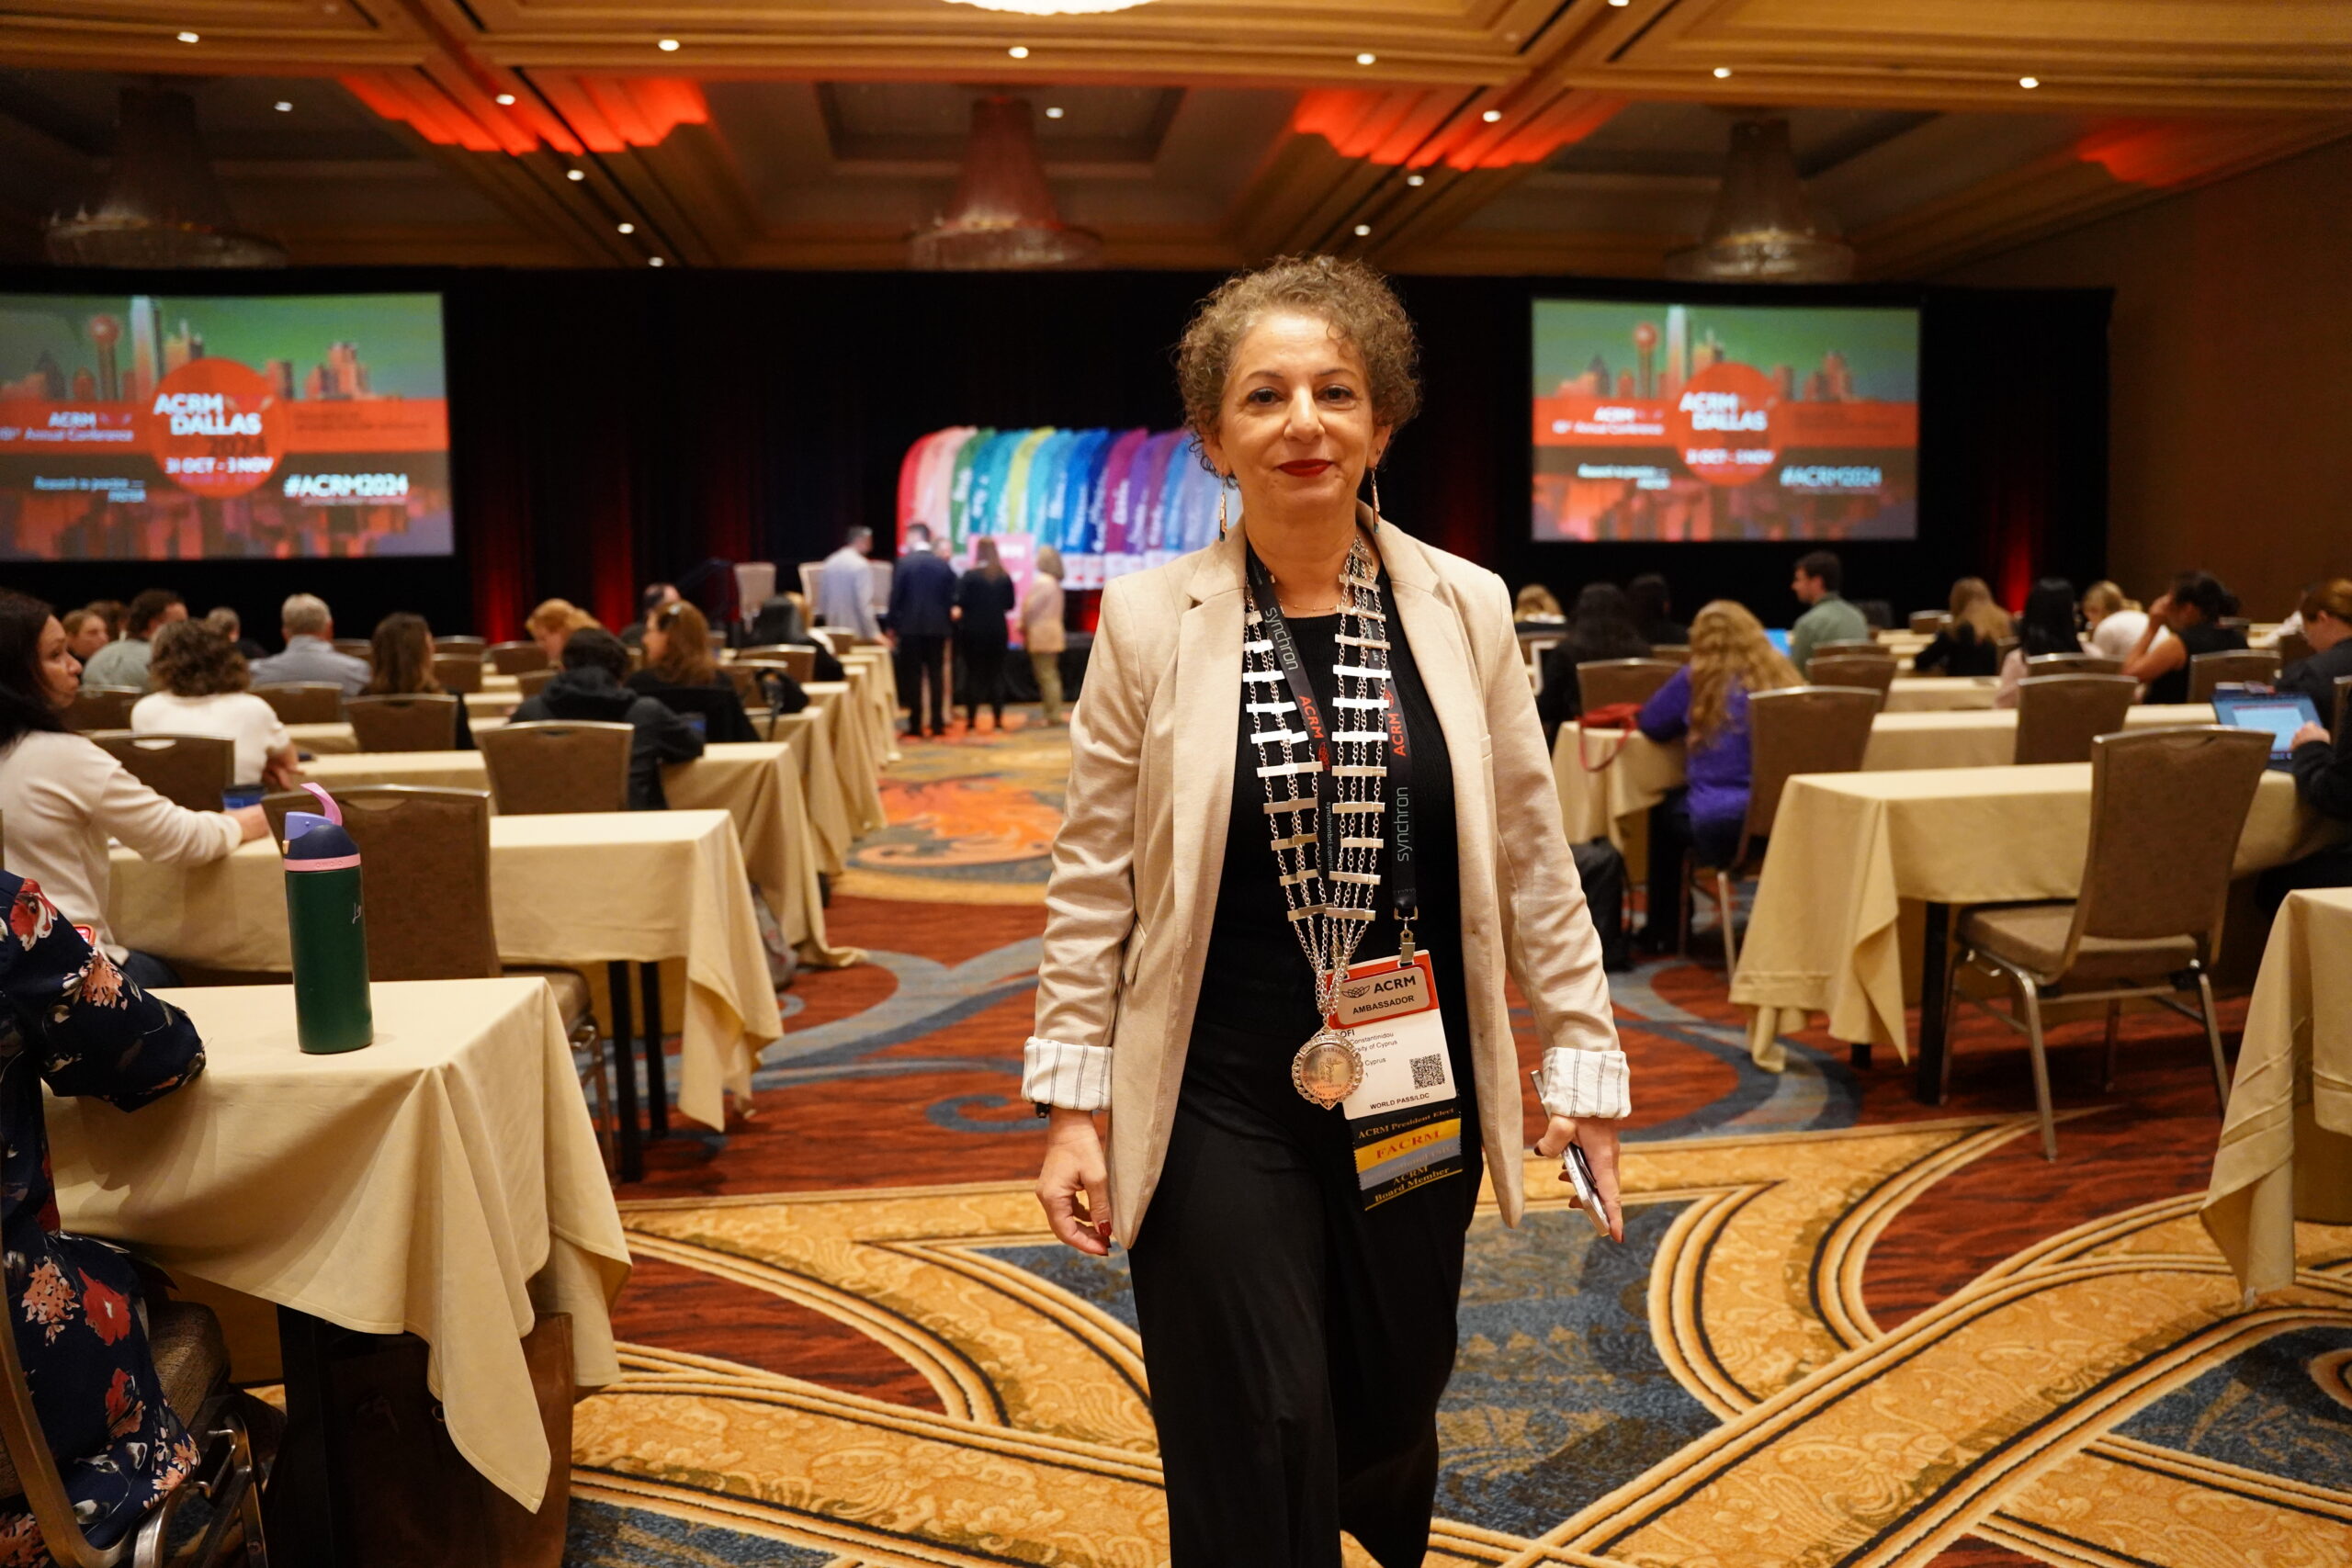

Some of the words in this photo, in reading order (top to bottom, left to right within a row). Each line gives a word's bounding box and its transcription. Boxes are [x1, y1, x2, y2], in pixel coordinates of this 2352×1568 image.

[153, 393, 224, 415] ACRM
[1679, 392, 1738, 412] ACRM
[170, 412, 263, 435] DALLAS
[1691, 411, 1769, 431] DALLAS
[182, 457, 216, 473] OCT
[238, 457, 274, 473] NOV
[283, 473, 409, 497] #ACRM2024
[1265, 606, 1299, 671] synchron
[1299, 694, 1325, 739] ACRM
[1387, 713, 1407, 757] ACRM
[1393, 786, 1413, 862] synchron
[1374, 976, 1417, 994] ACRM
[1352, 995, 1415, 1015] AMBASSADOR
[1369, 1043, 1376, 1051] of
[1376, 1039, 1398, 1051] Cyprus
[1364, 1057, 1386, 1067] Cyprus
[1370, 1099, 1396, 1111] WORLD
[1396, 1092, 1430, 1104] PASS/LDC
[1359, 1124, 1390, 1139] ACRM
[1391, 1114, 1431, 1131] President
[1432, 1108, 1454, 1119] Elect
[1375, 1130, 1442, 1159] FACRM
[1374, 1183, 1406, 1202] Board
[1408, 1167, 1451, 1189] Member
[1393, 1164, 1430, 1186] ACRM
